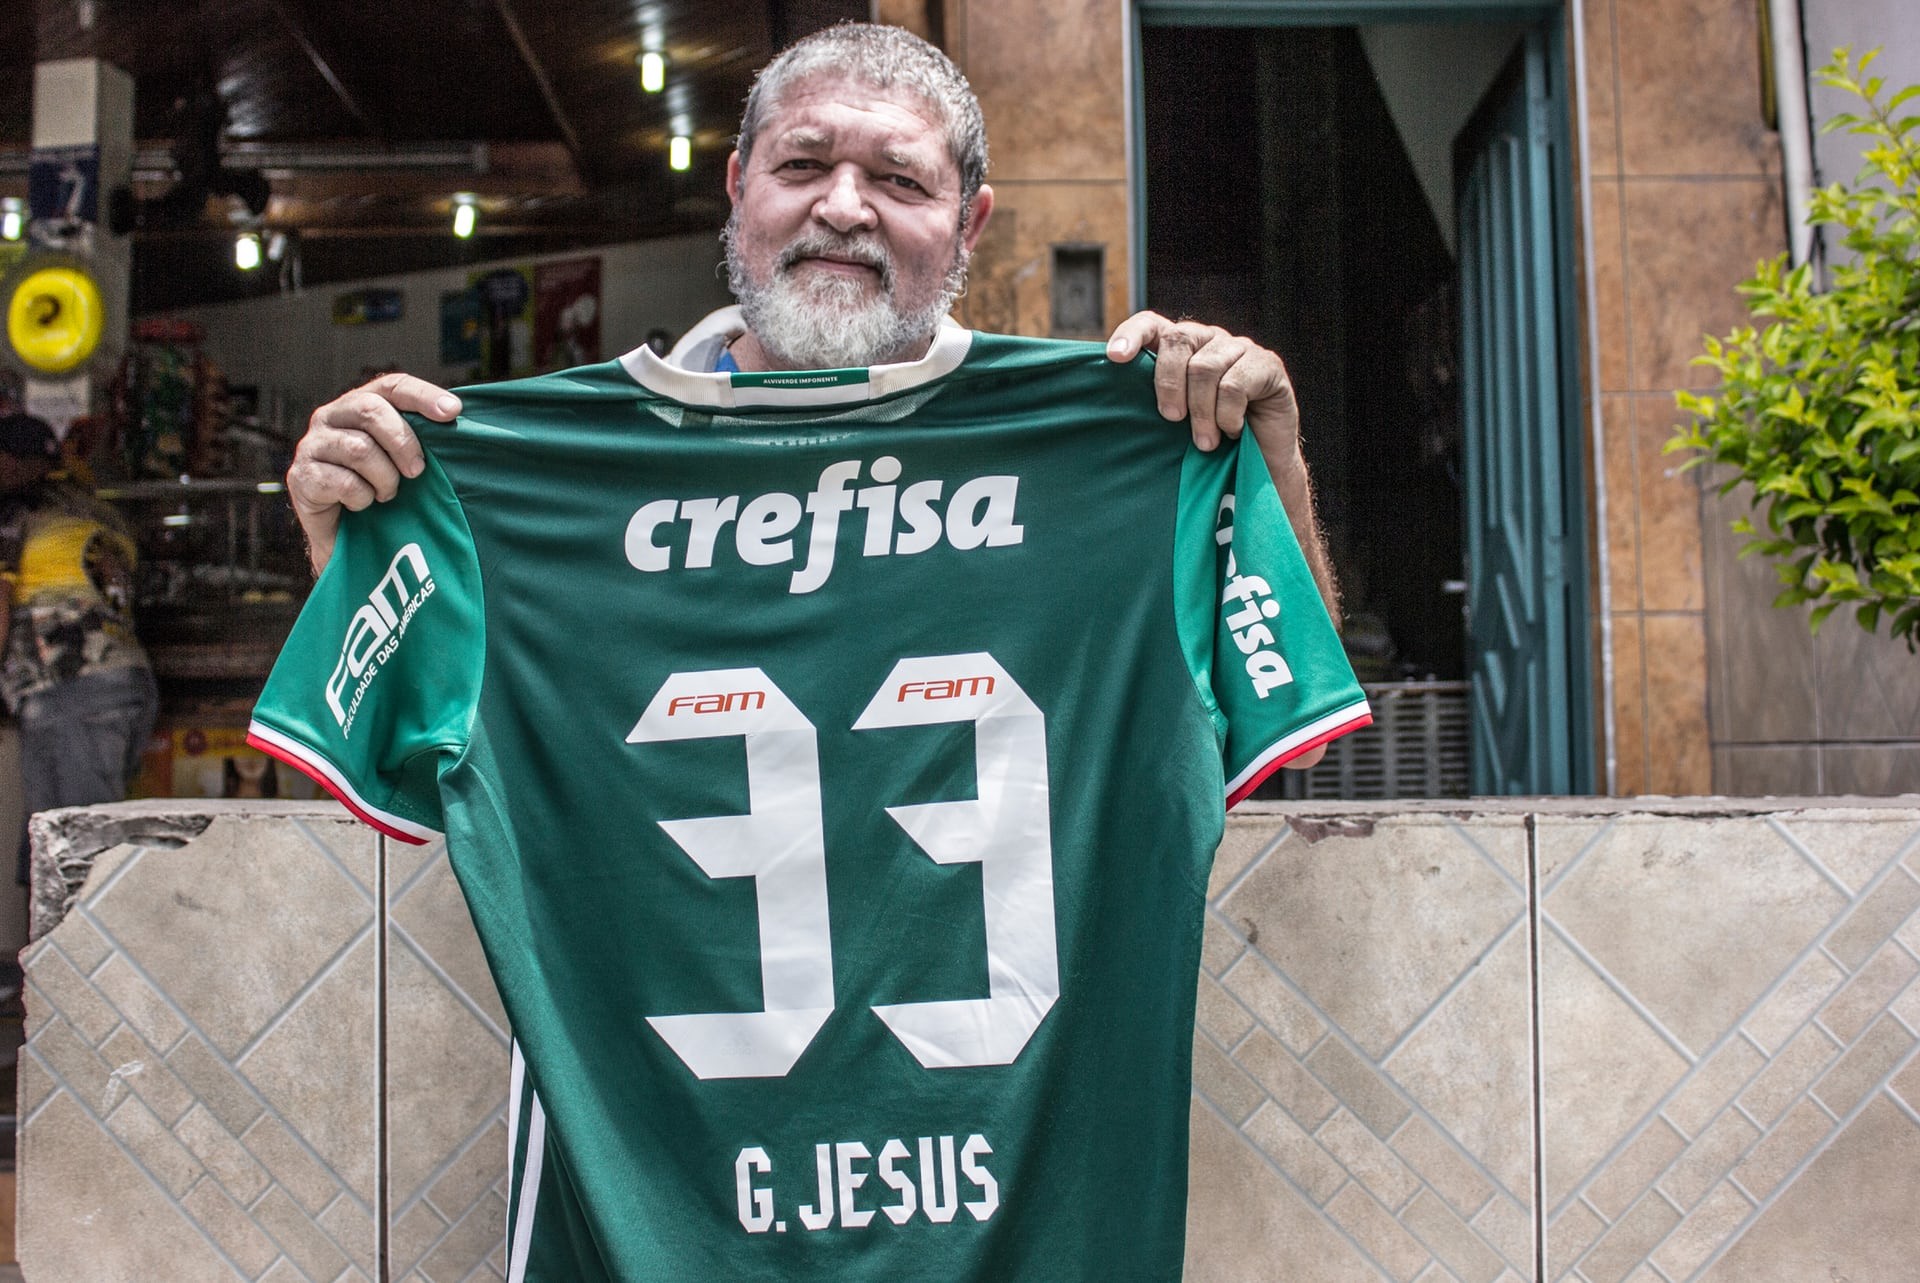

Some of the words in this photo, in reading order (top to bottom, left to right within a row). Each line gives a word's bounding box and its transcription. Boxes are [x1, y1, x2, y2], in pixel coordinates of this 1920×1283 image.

[799, 376, 838, 384] IMPONENTE
[624, 455, 1024, 594] crefisa
[343, 662, 378, 740] FACULDADE
[376, 636, 399, 665] DAS
[399, 578, 436, 640] AMÉRICAS
[625, 652, 1060, 1080] 33
[799, 1134, 999, 1231] JESUS
